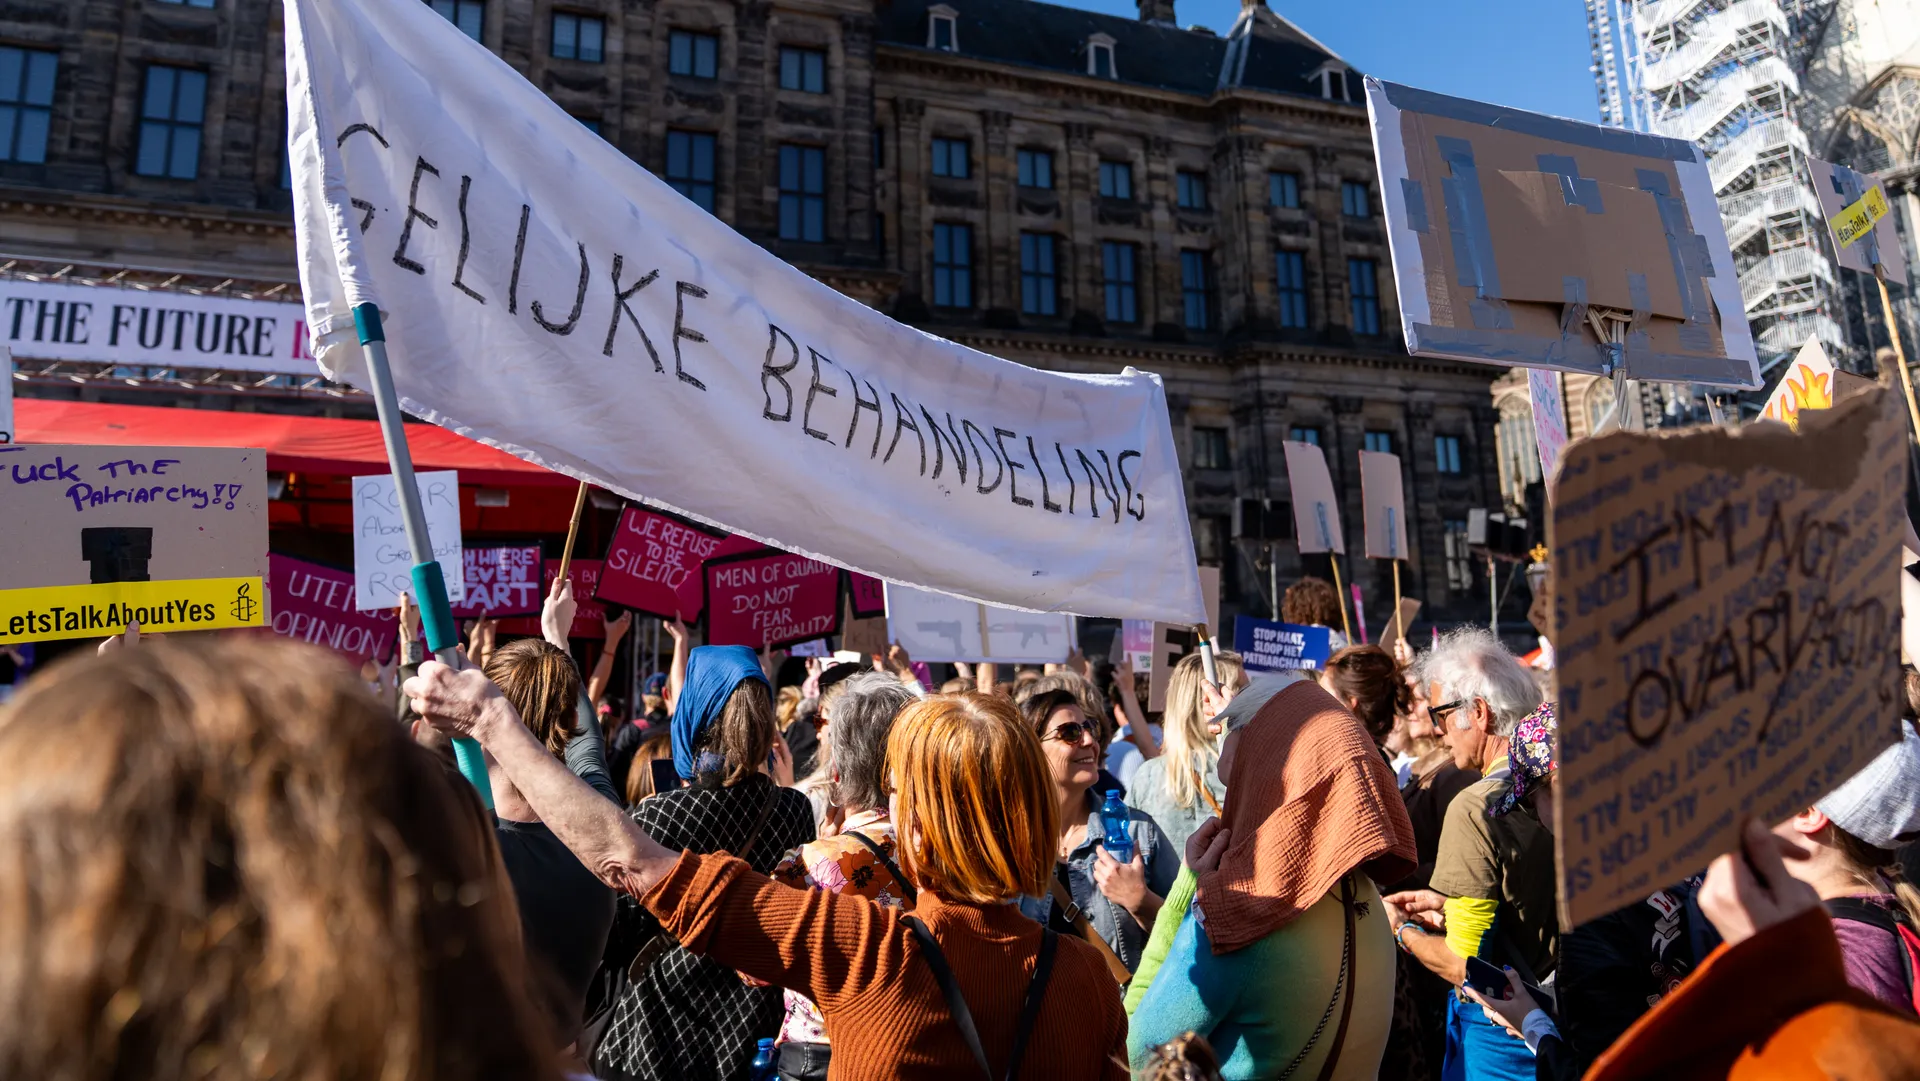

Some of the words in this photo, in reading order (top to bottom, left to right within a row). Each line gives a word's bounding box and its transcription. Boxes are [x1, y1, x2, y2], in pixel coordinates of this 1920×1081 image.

[5, 296, 93, 345] THE
[108, 304, 277, 357] FUTURE
[761, 323, 1146, 524] BEHANDELING
[628, 511, 657, 541] WE
[478, 547, 536, 567] WHERE
[645, 539, 663, 560] TO
[663, 549, 686, 568] BE
[466, 564, 528, 584] EVEN
[715, 566, 757, 589] MEN
[761, 562, 782, 584] OF
[1609, 500, 1736, 643] I'M
[1756, 500, 1850, 586] NOT
[732, 594, 760, 614] DO
[764, 584, 800, 606] NOT
[752, 607, 793, 630] FEAR
[762, 614, 834, 644] EQUALITY
[272, 610, 386, 658] OPINION
[1253, 627, 1276, 641] STOP
[1242, 651, 1316, 669] PATRIARCHAAT!
[1253, 641, 1283, 655] SLOOP
[1284, 645, 1304, 657] HET
